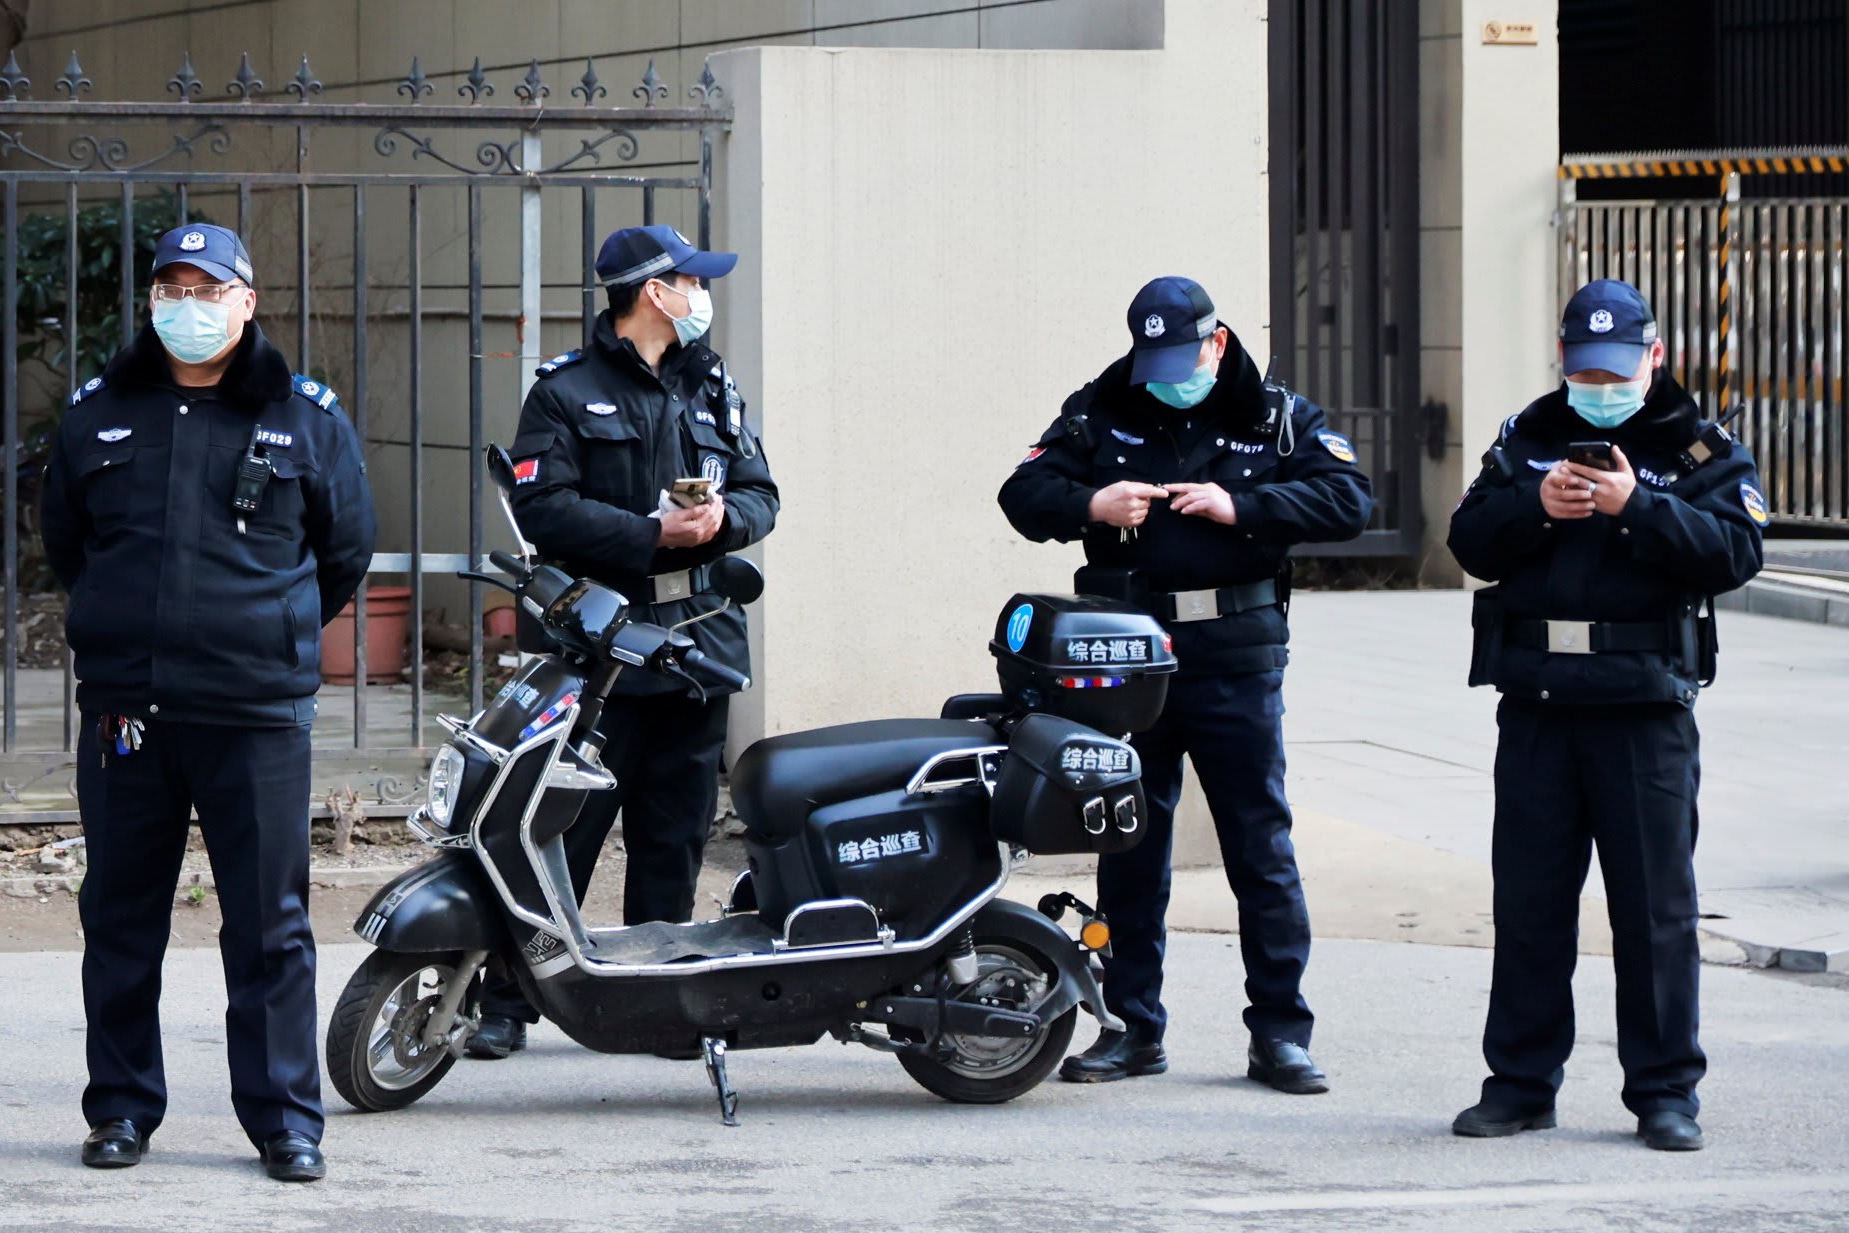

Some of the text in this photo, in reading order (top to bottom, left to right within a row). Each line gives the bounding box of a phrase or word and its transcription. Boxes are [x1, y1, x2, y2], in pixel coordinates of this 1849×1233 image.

[1012, 612, 1029, 642] 10
[1067, 639, 1148, 663] 综合巡查
[1061, 746, 1130, 771] 综合巡查
[838, 830, 922, 863] 综合巡查
